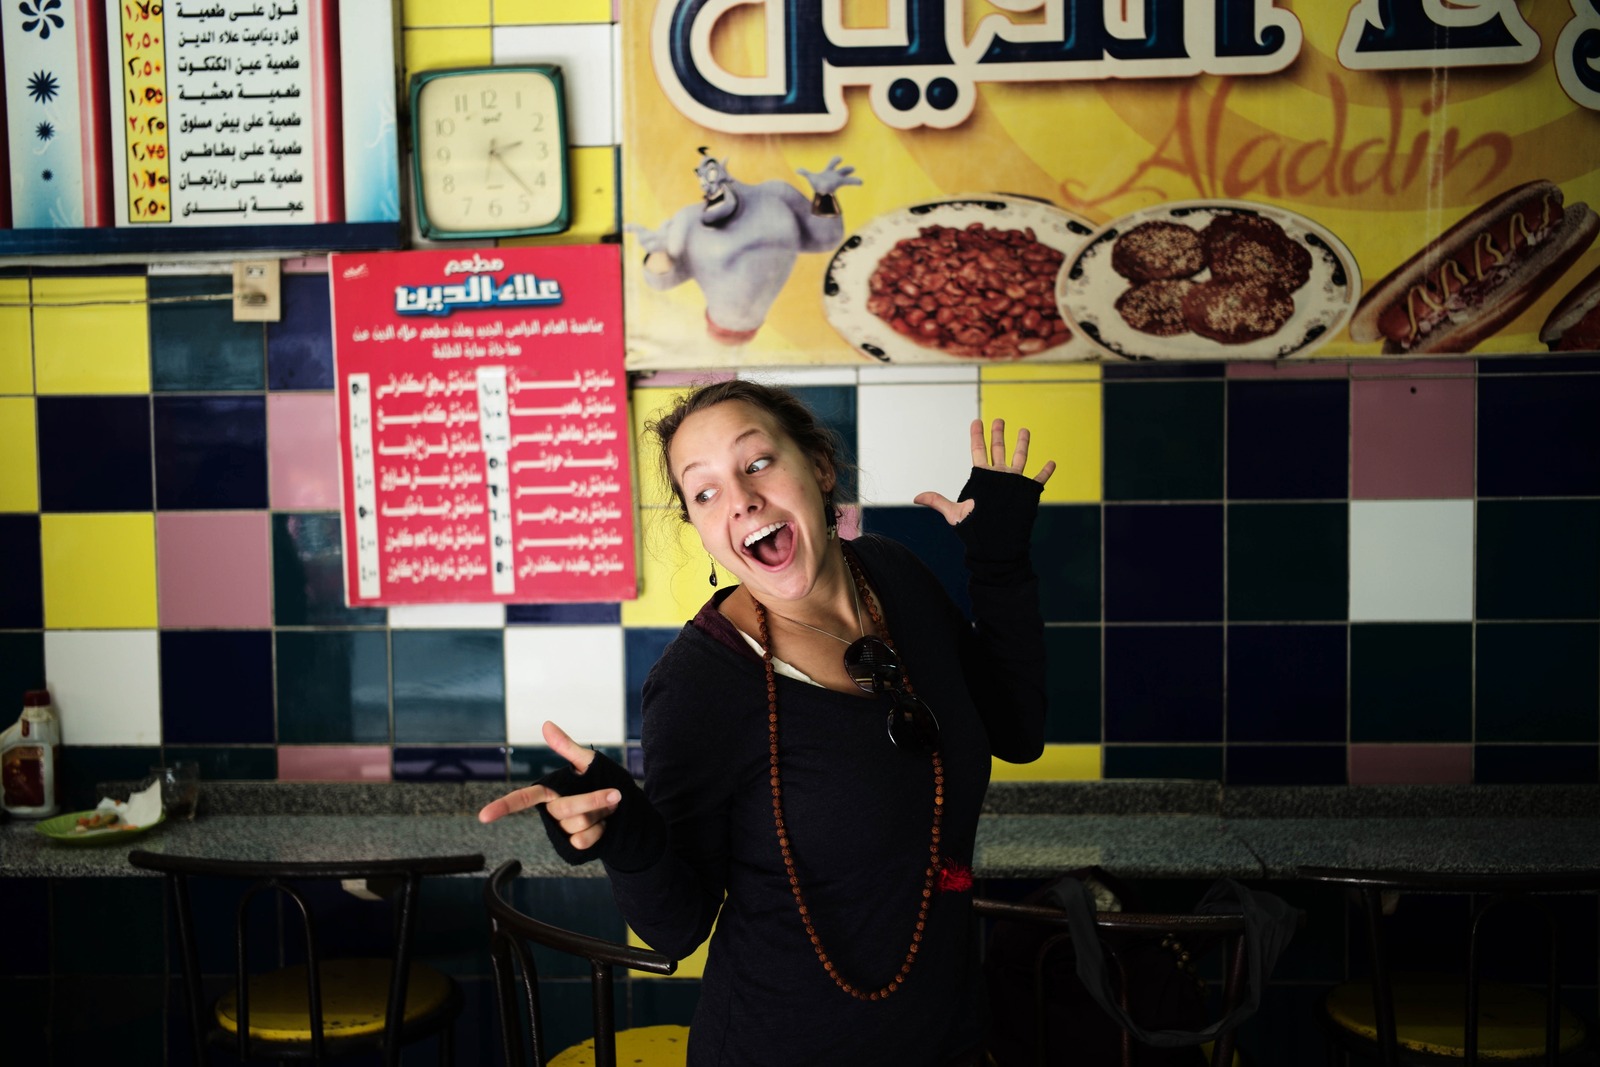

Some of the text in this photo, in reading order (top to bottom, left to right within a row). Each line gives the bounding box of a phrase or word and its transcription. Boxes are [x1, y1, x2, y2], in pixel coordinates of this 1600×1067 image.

[177, 2, 225, 21] طعمية
[230, 3, 264, 21] على
[178, 28, 299, 48] فول ديناميت علاء الدين
[178, 55, 300, 76] طعمية عين الكتكوت
[178, 81, 301, 104] طعمية محشية
[480, 89, 497, 109] 12
[515, 91, 522, 109] 1
[455, 94, 468, 113] 11
[180, 111, 301, 133] طعمية على بيض مسلوق
[435, 118, 455, 137] 10
[532, 112, 544, 132] 2
[1060, 72, 1513, 207] Aladdin
[180, 140, 302, 162] طعمية على بطاطس
[437, 146, 451, 164] 9
[536, 141, 548, 160] 3
[230, 172, 265, 189] على
[269, 169, 303, 188] طعمية
[442, 174, 455, 194] 8
[534, 171, 546, 187] 4
[252, 197, 304, 216] عجة
[463, 196, 473, 216] 7
[488, 200, 503, 218] 6
[519, 194, 530, 214] 5
[444, 252, 504, 276] مطعم
[395, 273, 563, 312] علاء الدين
[419, 323, 450, 342] مطعم
